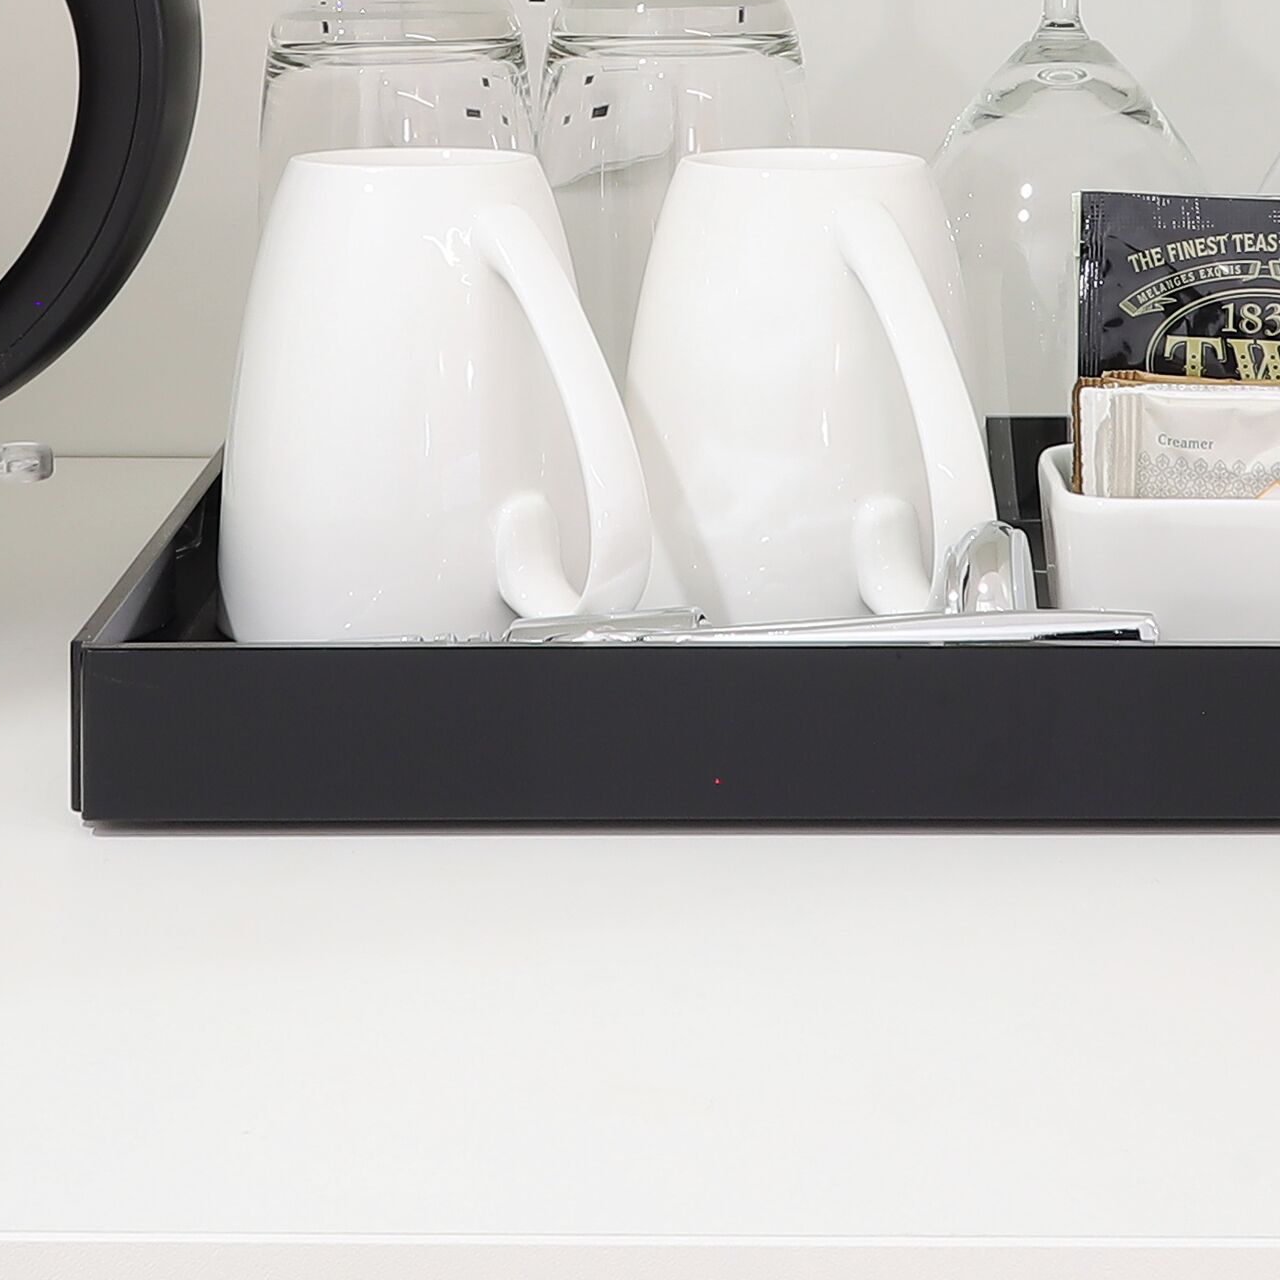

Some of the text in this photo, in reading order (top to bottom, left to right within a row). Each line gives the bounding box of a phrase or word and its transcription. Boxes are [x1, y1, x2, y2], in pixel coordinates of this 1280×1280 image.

[1127, 247, 1165, 273] THE
[1166, 233, 1229, 263] FINEST
[1231, 233, 1278, 253] TEAS
[1136, 271, 1196, 304] MELANGES
[1158, 433, 1214, 450] Creamer
